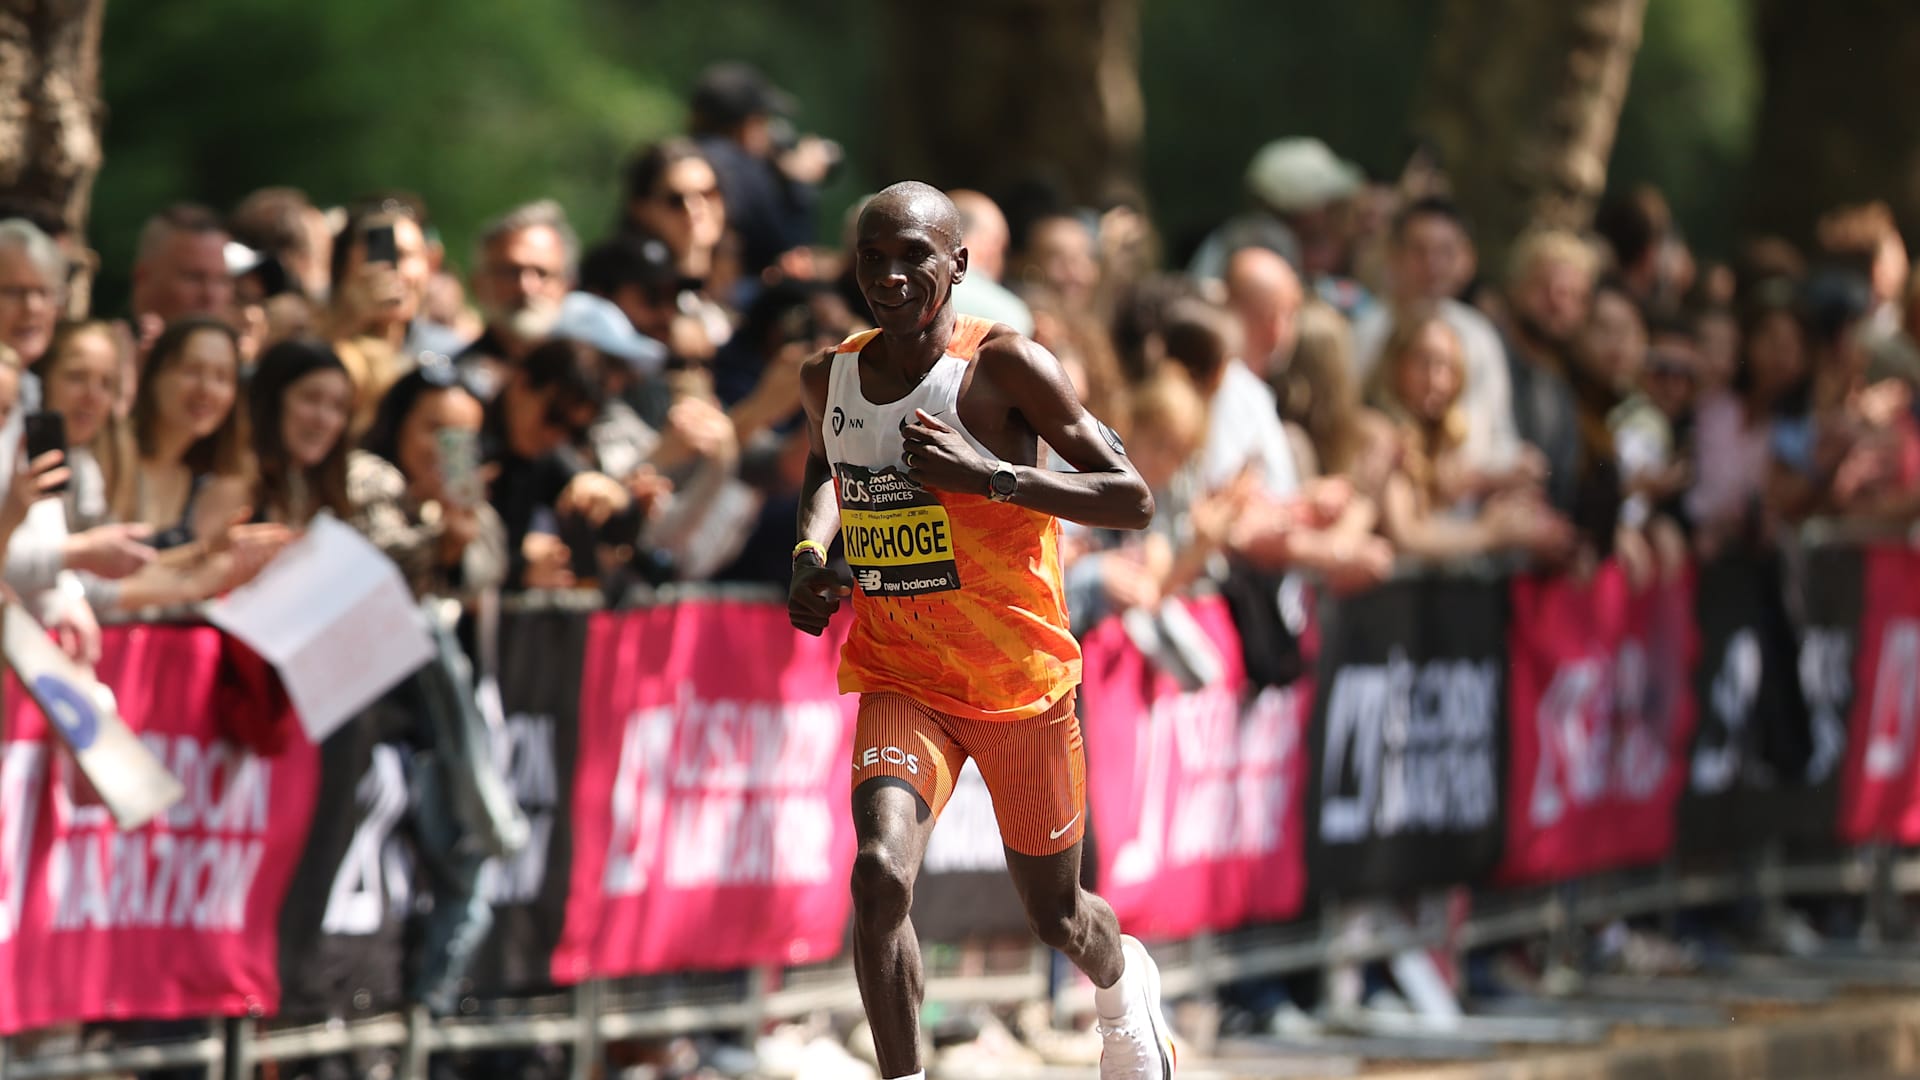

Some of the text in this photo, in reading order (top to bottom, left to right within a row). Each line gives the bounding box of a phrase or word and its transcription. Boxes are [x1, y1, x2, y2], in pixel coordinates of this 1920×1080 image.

[849, 418, 864, 429] NN
[841, 471, 870, 503] tcs
[869, 481, 911, 493] CONSUL
[871, 490, 914, 504] SERVICES
[846, 520, 948, 559] KIPCHOGE
[883, 577, 948, 591] new balance
[55, 732, 271, 832] LDON
